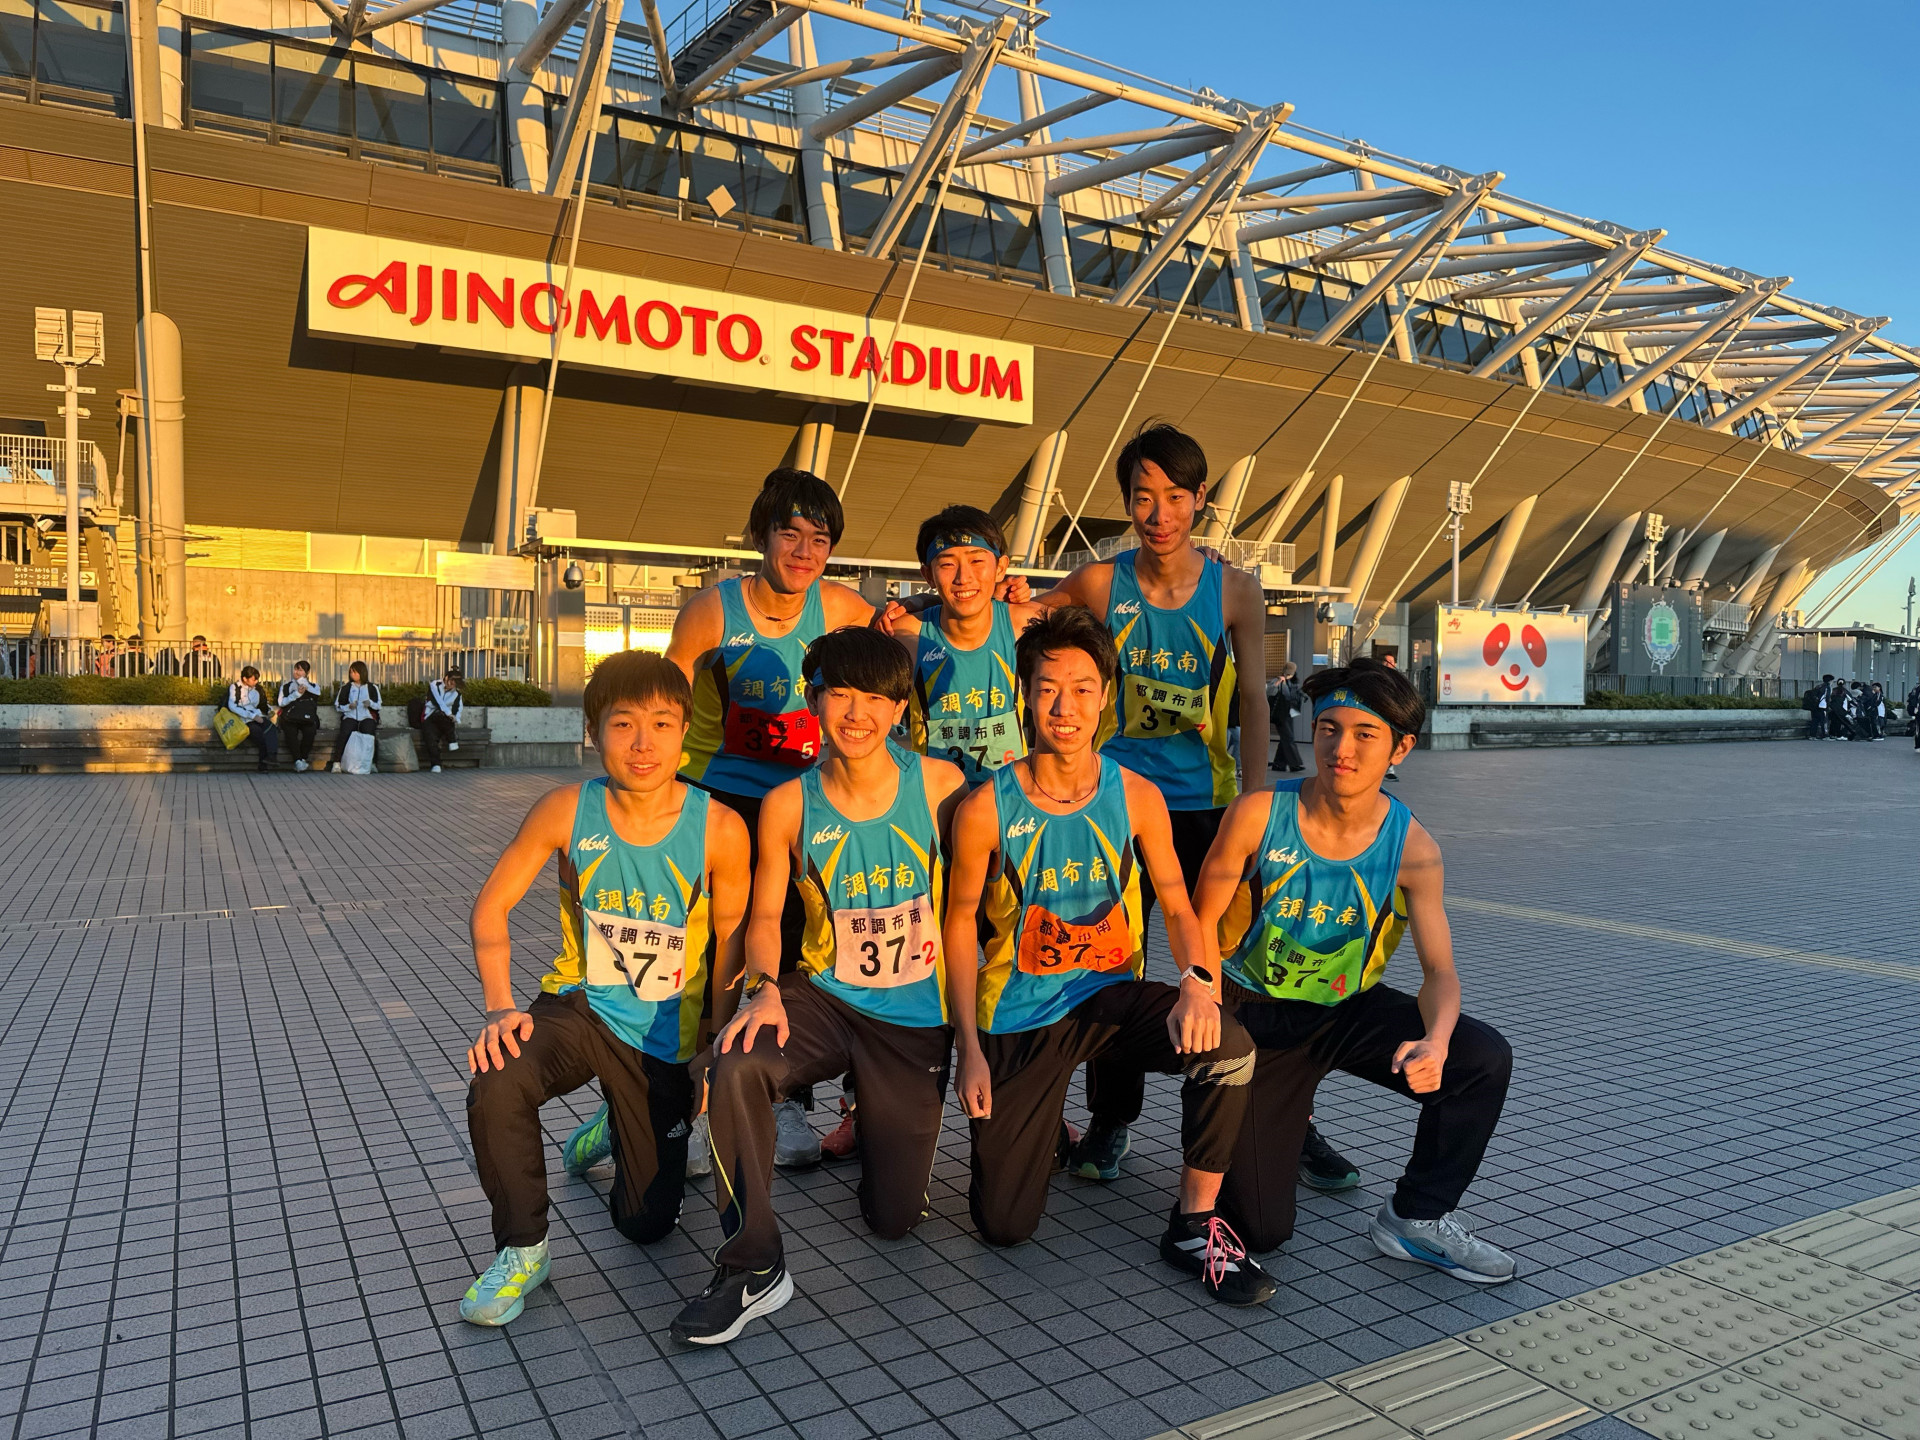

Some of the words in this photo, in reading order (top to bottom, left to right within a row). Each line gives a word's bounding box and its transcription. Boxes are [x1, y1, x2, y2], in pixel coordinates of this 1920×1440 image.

[327, 260, 764, 363] AJINOMOTO
[790, 325, 1024, 402] STADIUM
[1128, 646, 1199, 674] 調布南
[939, 686, 1006, 713] 調布南
[1135, 683, 1204, 709] 都調布南
[941, 722, 1006, 740] 都調布南
[947, 744, 1017, 774] 37-6
[841, 862, 916, 899] 調布南
[1033, 856, 1109, 892] 調布南
[594, 888, 671, 922] 調布南
[1276, 896, 1361, 928] 調布南
[851, 907, 922, 935] 都調布南
[598, 922, 685, 951] 都調布南
[859, 935, 937, 977] 37-2
[1039, 943, 1124, 968] 37-3
[1263, 959, 1348, 997] 37-4
